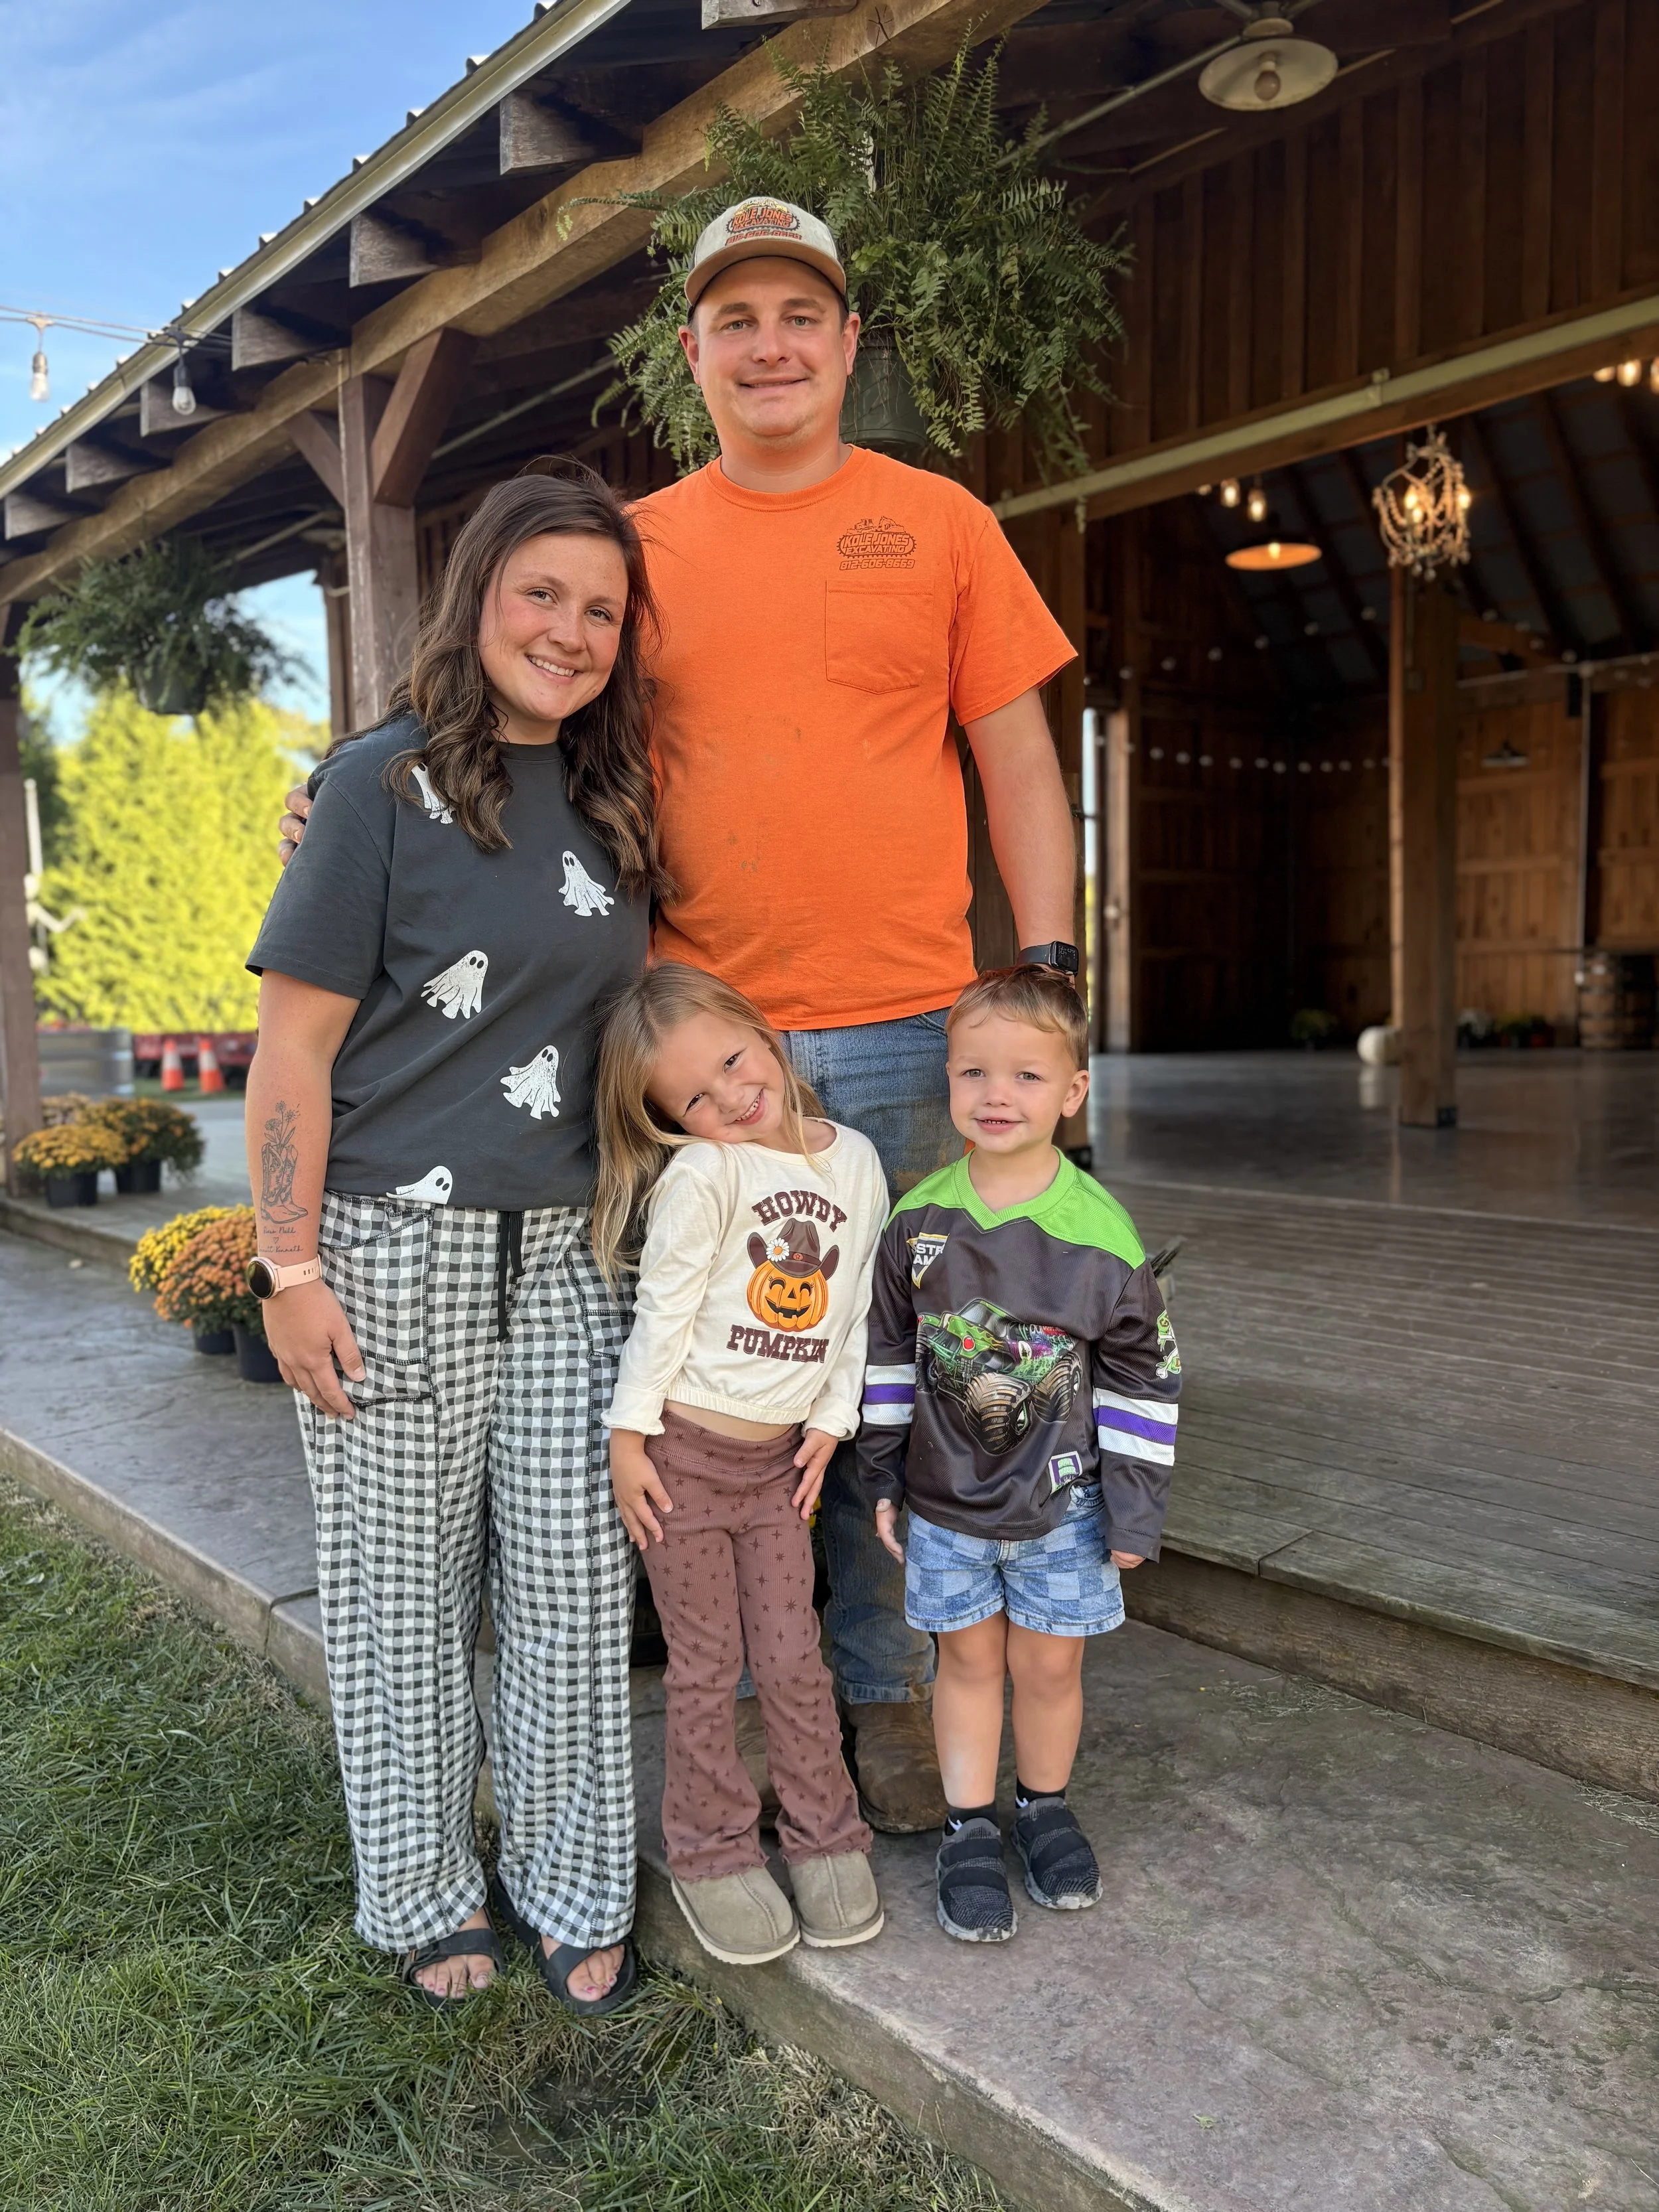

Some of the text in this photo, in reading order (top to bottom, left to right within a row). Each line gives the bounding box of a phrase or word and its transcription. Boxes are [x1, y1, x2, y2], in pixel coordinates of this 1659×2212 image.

[733, 206, 794, 226] KOLE JONES
[733, 218, 790, 232] EXCAVATING
[843, 533, 910, 548] KOLE JONES
[845, 545, 906, 555] EXCAVATING
[839, 559, 915, 571] 812-606-8669
[751, 1190, 848, 1232] HOWDY
[726, 1324, 830, 1364] PUMPKIN
